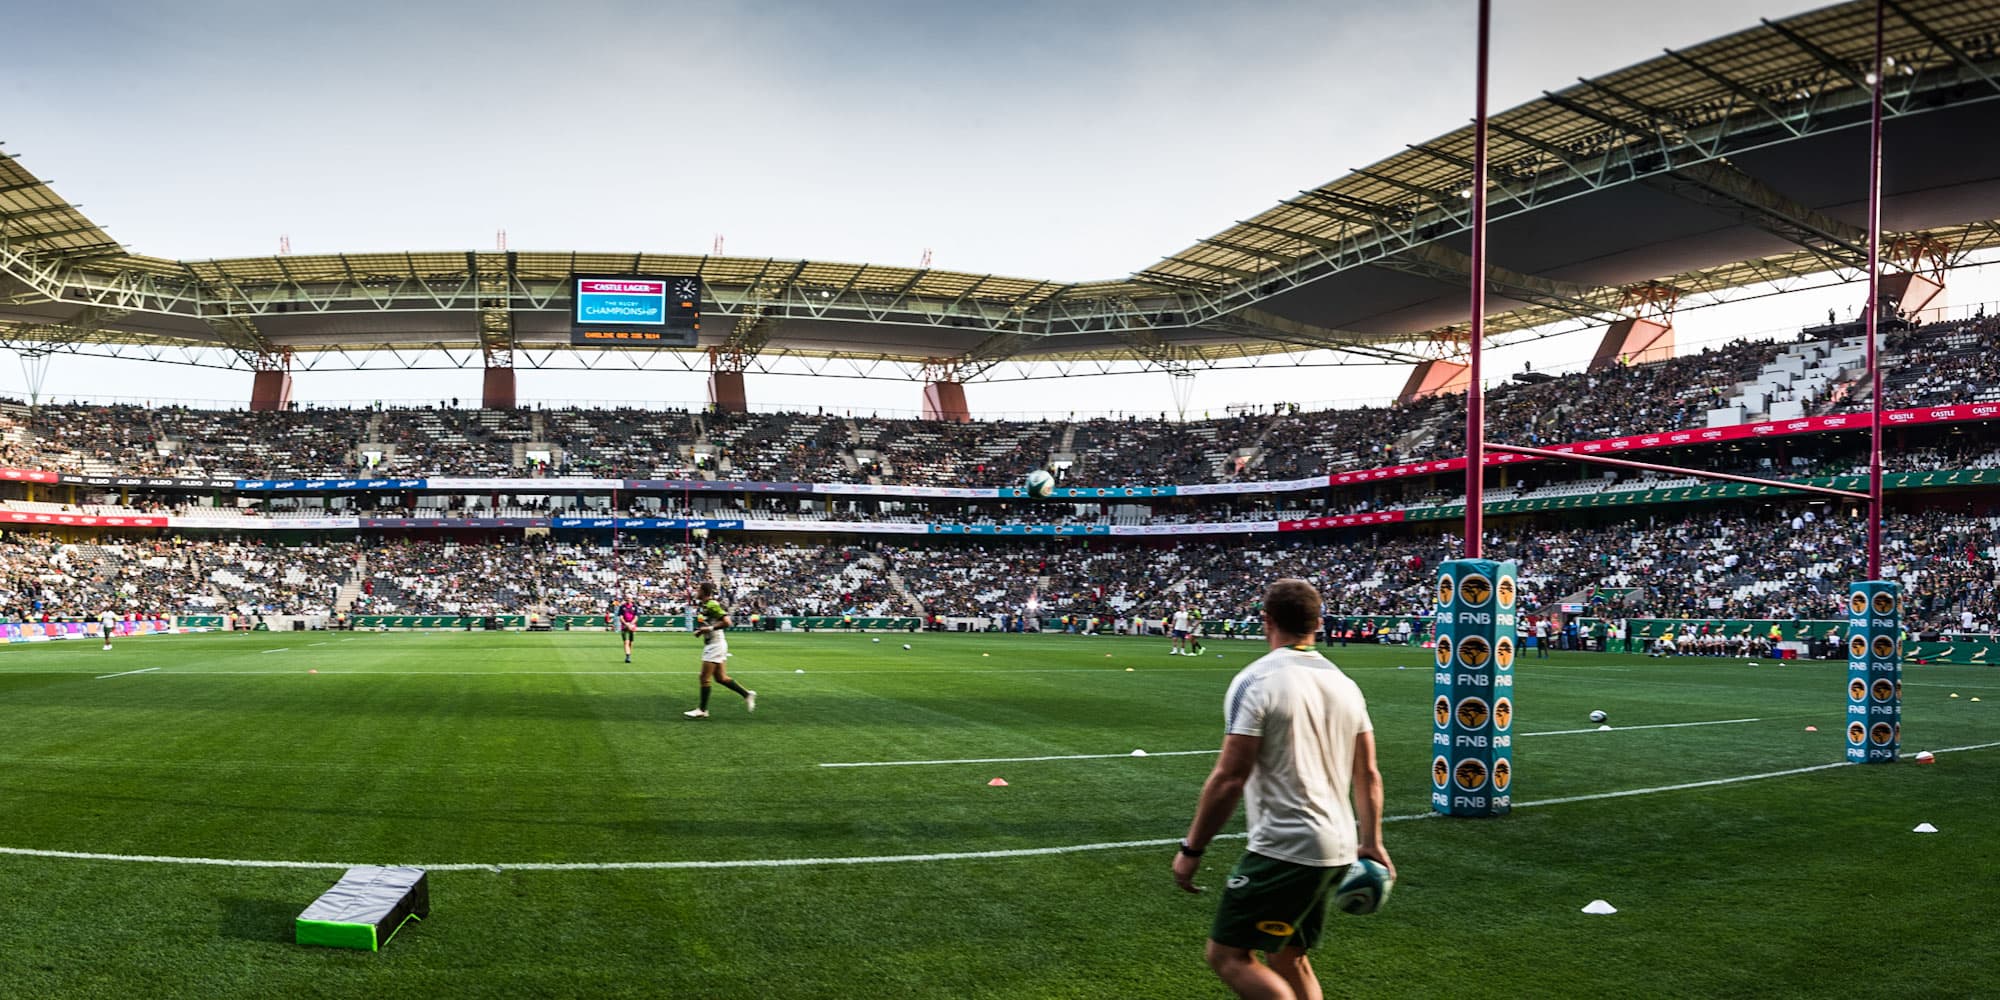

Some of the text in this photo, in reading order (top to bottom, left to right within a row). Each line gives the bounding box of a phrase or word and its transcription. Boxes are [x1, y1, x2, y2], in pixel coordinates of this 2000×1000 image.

[586, 307, 657, 315] CHAMPIONSHIP
[1931, 410, 1955, 418] CASTLE
[1437, 613, 1453, 624] FNB
[1459, 613, 1491, 624] FNB
[1496, 614, 1513, 626] FNB
[1872, 619, 1894, 628] FNB
[1872, 663, 1894, 672] FNB
[1436, 673, 1451, 685] FNB
[1457, 674, 1489, 686] FNB
[1494, 675, 1512, 687] FNB
[1871, 706, 1893, 715] FNB
[1434, 733, 1449, 745] FNB
[1456, 735, 1488, 747] FNB
[1493, 735, 1511, 748] FNB
[1432, 793, 1448, 807] FNB
[1454, 796, 1486, 808] FNB
